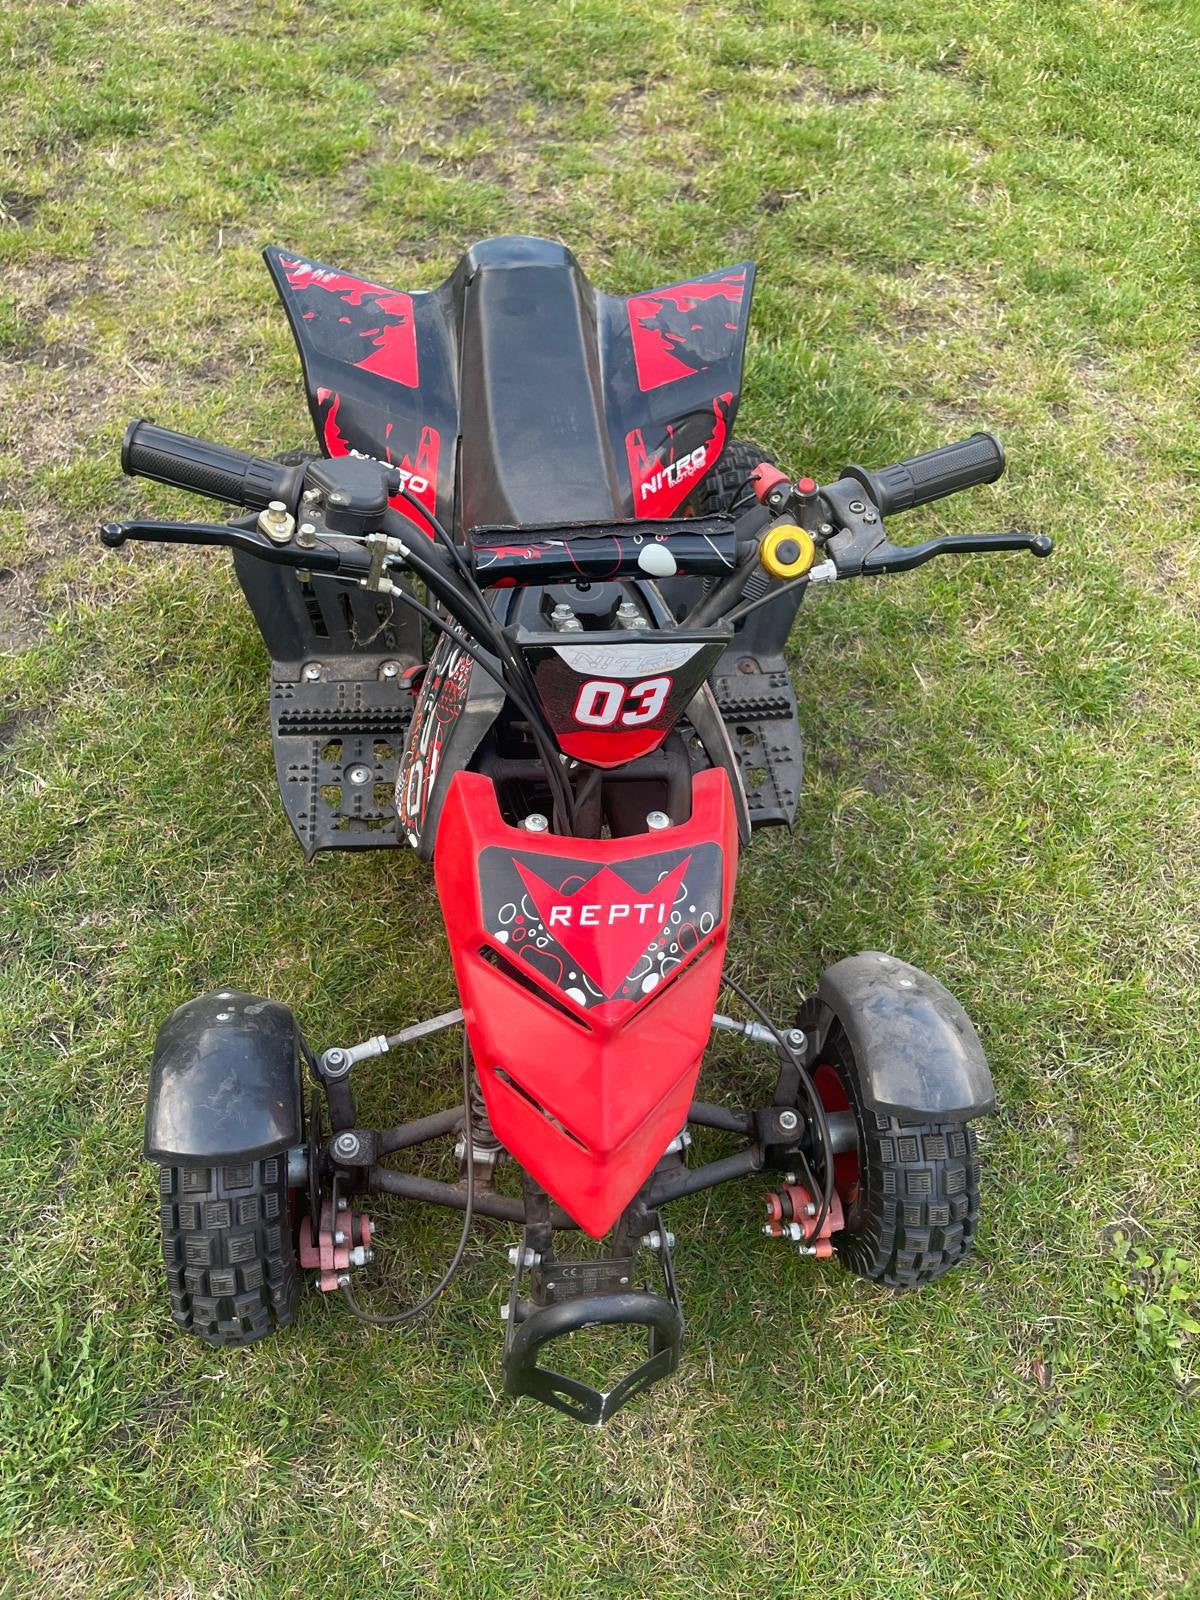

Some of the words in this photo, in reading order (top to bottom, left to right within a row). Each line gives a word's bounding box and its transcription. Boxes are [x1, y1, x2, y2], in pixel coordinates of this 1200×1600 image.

[641, 446, 706, 500] NITRO
[570, 648, 690, 672] NITRO
[573, 676, 673, 727] 03
[549, 903, 665, 927] REPTI
